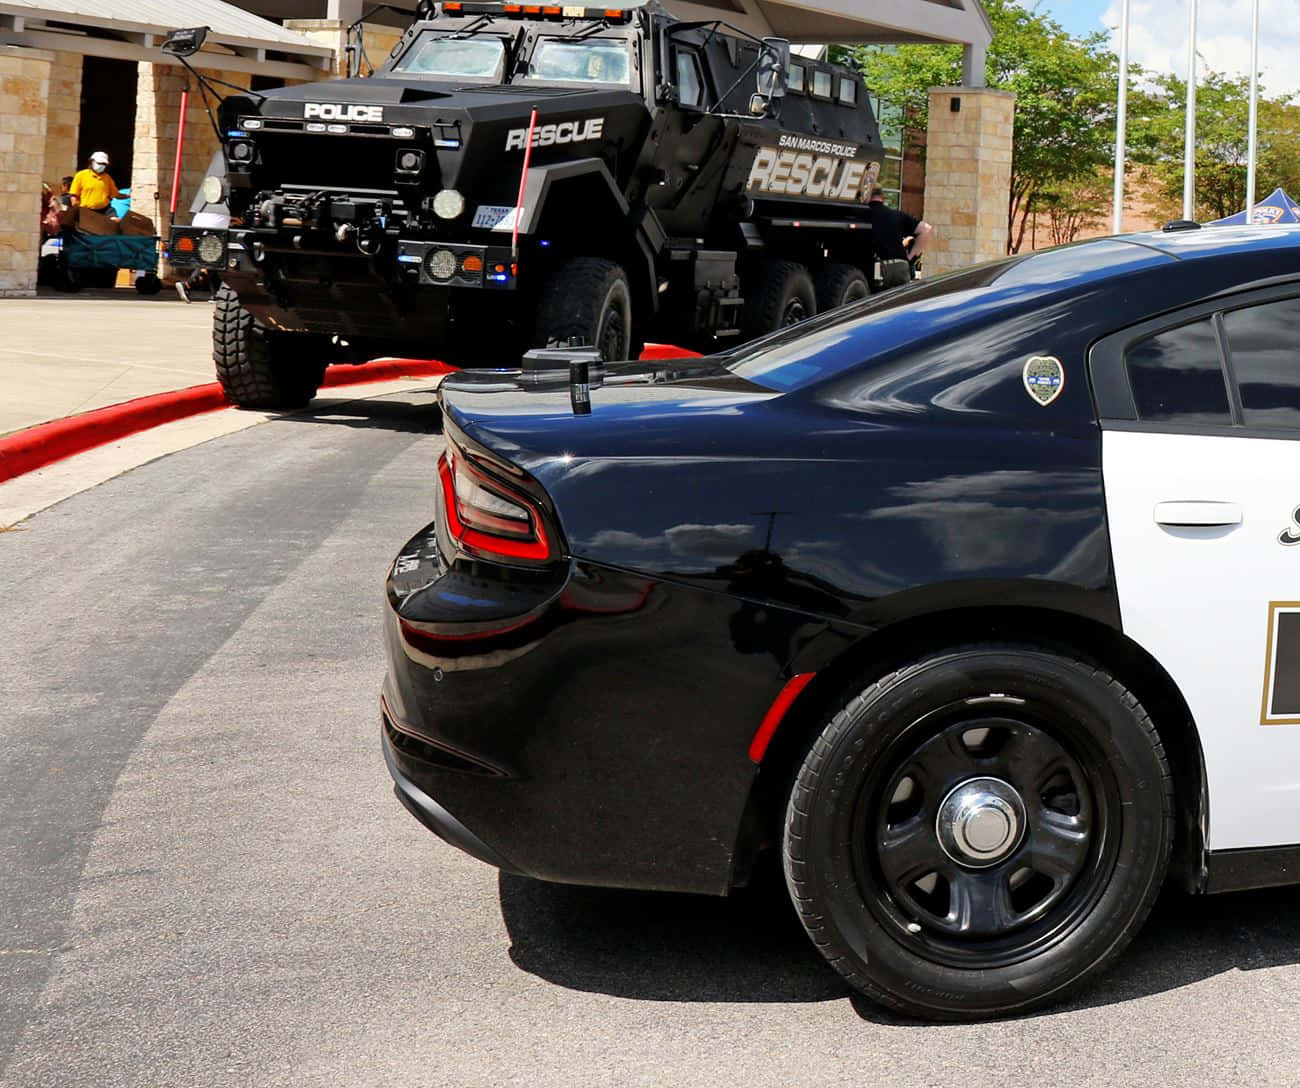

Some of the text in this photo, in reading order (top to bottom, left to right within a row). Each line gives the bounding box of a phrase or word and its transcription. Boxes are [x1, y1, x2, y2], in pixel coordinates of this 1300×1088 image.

[304, 103, 383, 121] POLICE
[505, 118, 604, 151] RESCUE
[779, 135, 857, 158] SAN MARCOS POLICE
[746, 146, 866, 202] RESCUE
